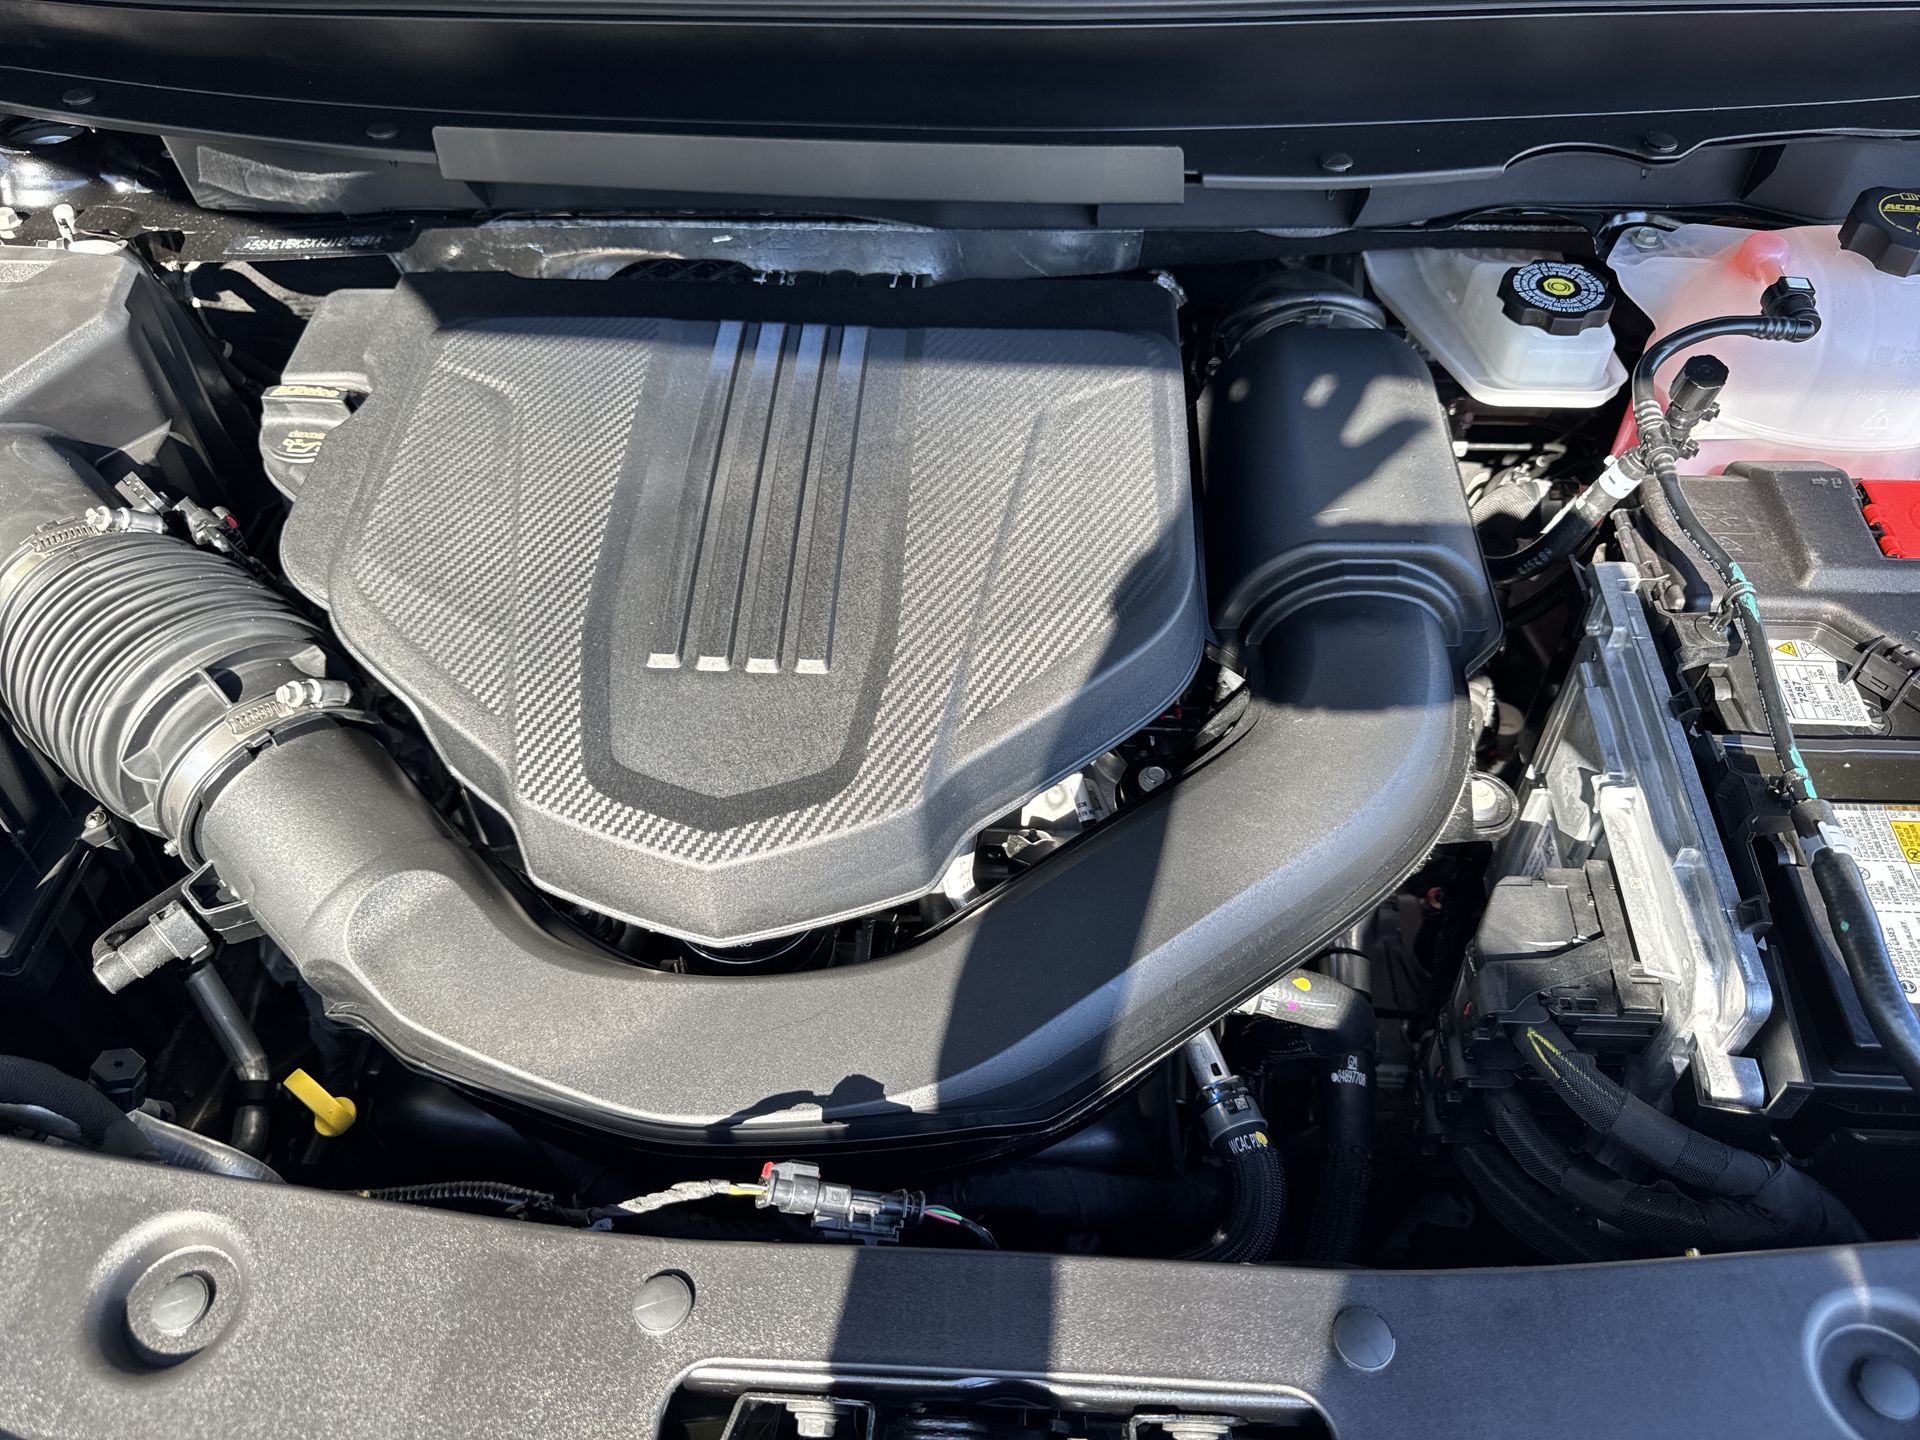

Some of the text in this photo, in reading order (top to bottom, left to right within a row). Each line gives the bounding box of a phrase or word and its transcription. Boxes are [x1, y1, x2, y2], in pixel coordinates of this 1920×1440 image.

[1816, 668, 1826, 680] 730
[1792, 681, 1809, 703] 7287
[1802, 676, 1820, 706] 12V VRLA
[1832, 705, 1842, 716] 730
[1886, 927, 1900, 945] GASES
[1228, 1135, 1252, 1155] WCAC
